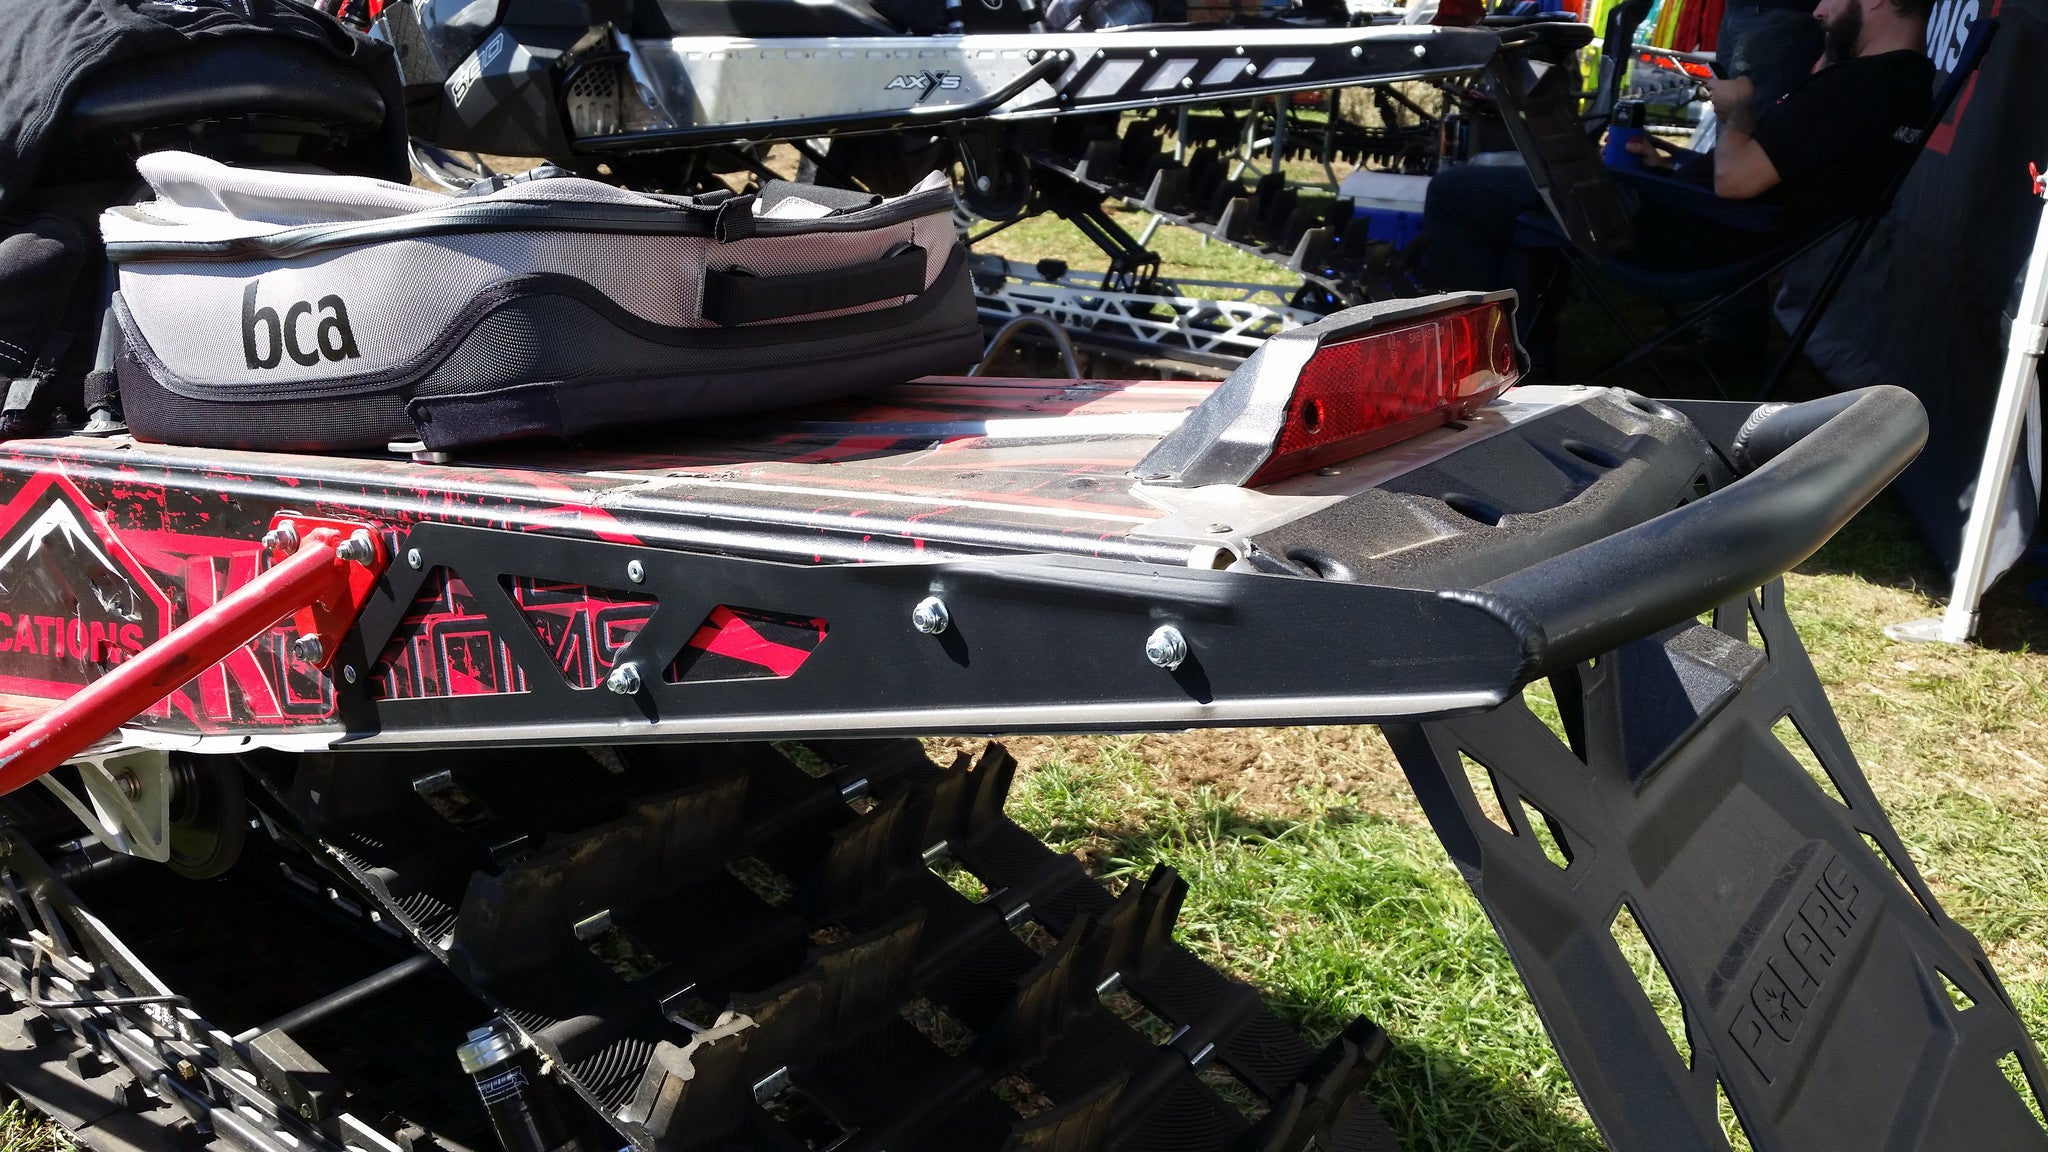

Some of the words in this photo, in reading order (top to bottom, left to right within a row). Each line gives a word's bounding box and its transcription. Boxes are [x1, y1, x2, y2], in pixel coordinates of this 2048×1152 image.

[884, 69, 962, 103] AXYS
[241, 279, 361, 370] bca
[1728, 854, 1866, 1086] POLARIS
